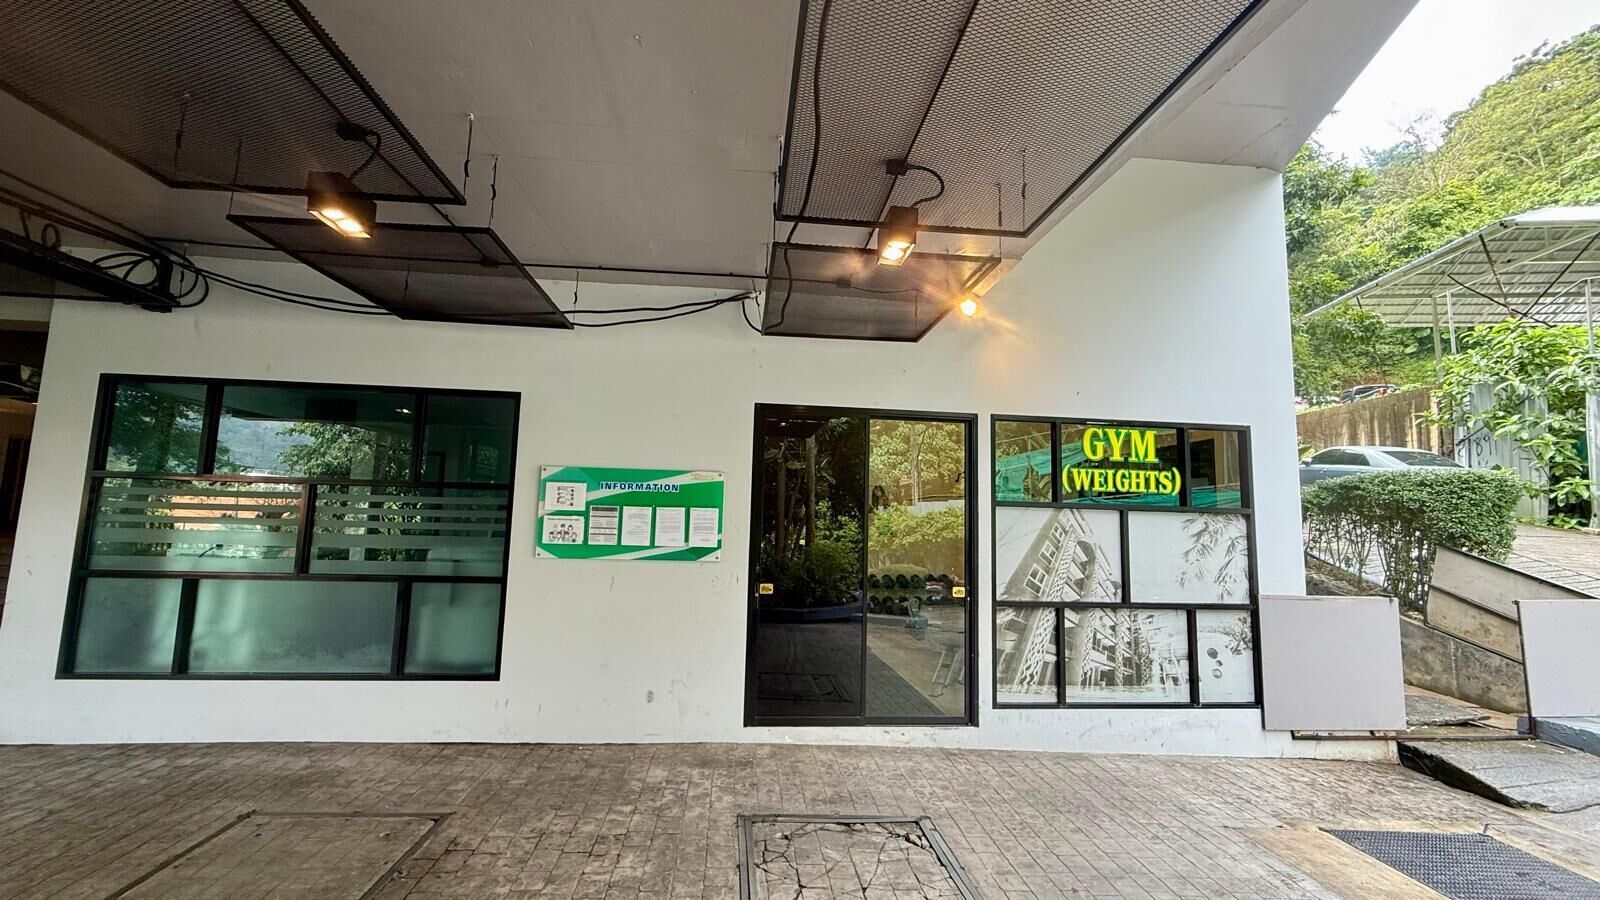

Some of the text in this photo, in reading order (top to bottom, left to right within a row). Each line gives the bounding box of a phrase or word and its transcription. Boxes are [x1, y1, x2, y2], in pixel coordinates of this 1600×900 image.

[1083, 426, 1159, 463] GYM
[600, 481, 680, 493] INFORMATION
[1062, 464, 1182, 496] (WEIGHTS)
